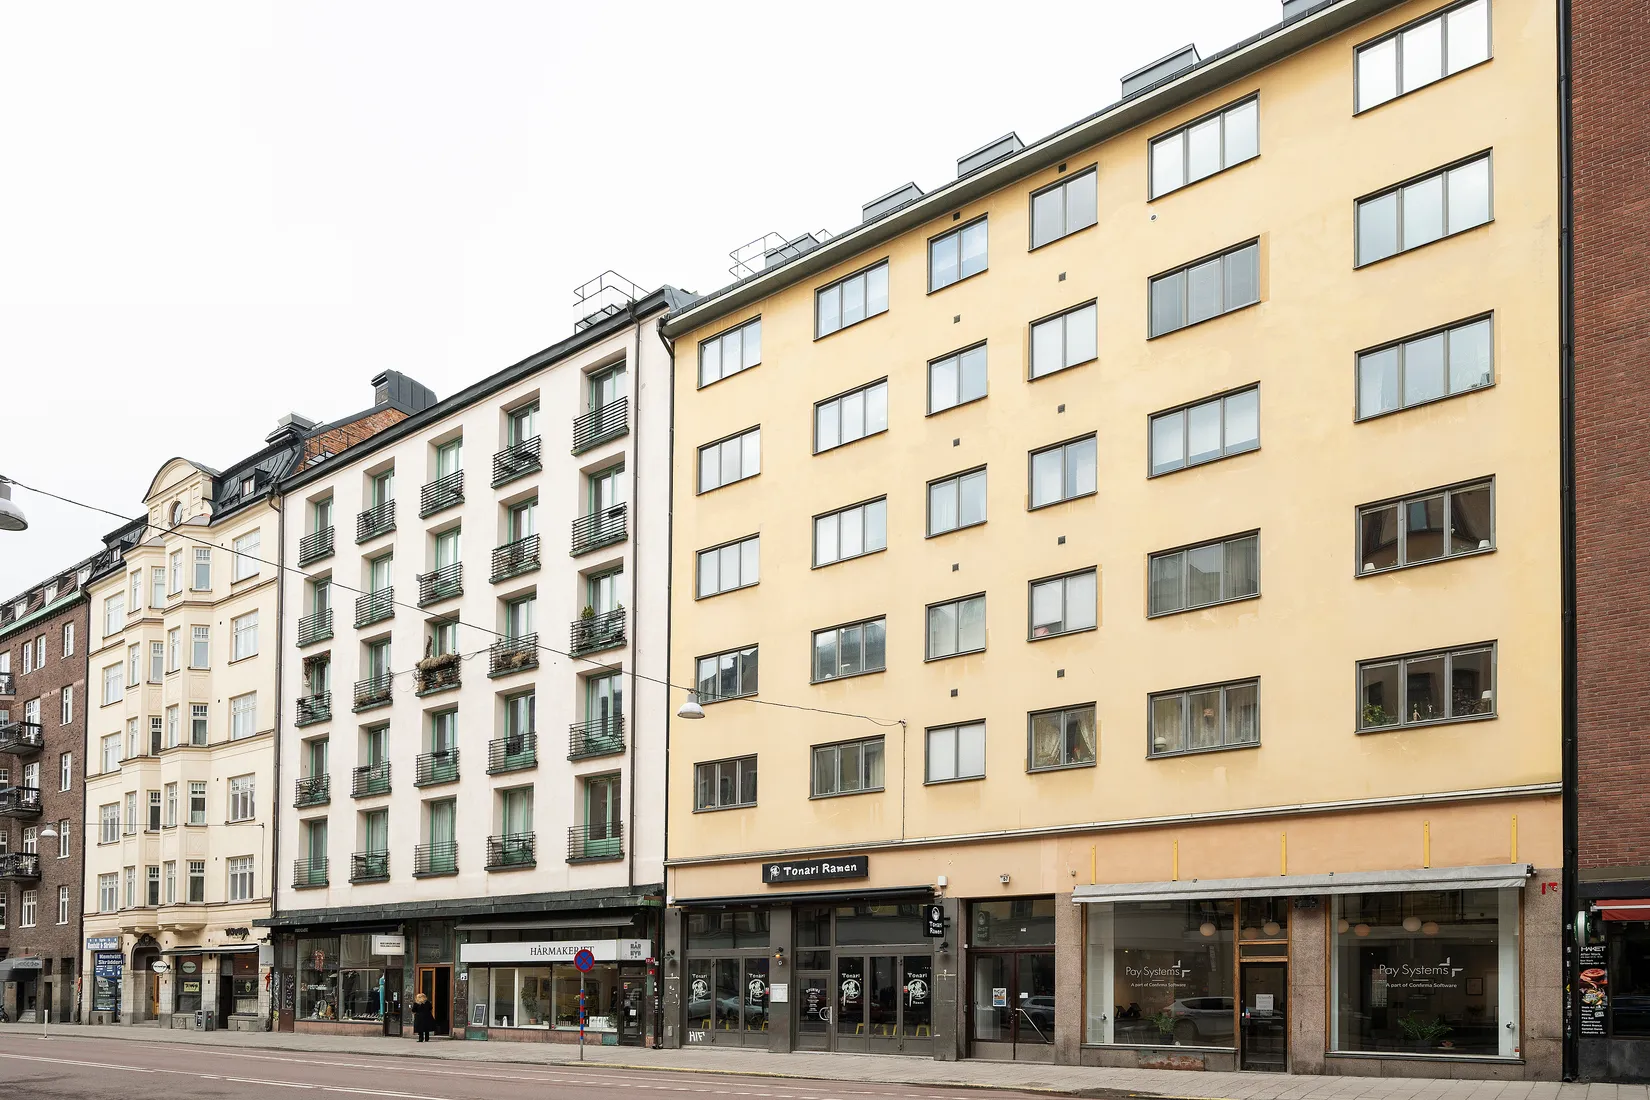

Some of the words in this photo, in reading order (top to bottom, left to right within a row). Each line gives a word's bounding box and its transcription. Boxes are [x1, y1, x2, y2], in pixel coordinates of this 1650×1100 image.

[783, 866, 818, 876] Tonari
[822, 864, 857, 874] Ramen
[1126, 966, 1141, 978] Pay
[1144, 966, 1180, 978] Systems
[1380, 964, 1400, 977] Pay
[1402, 964, 1449, 977] Systems
